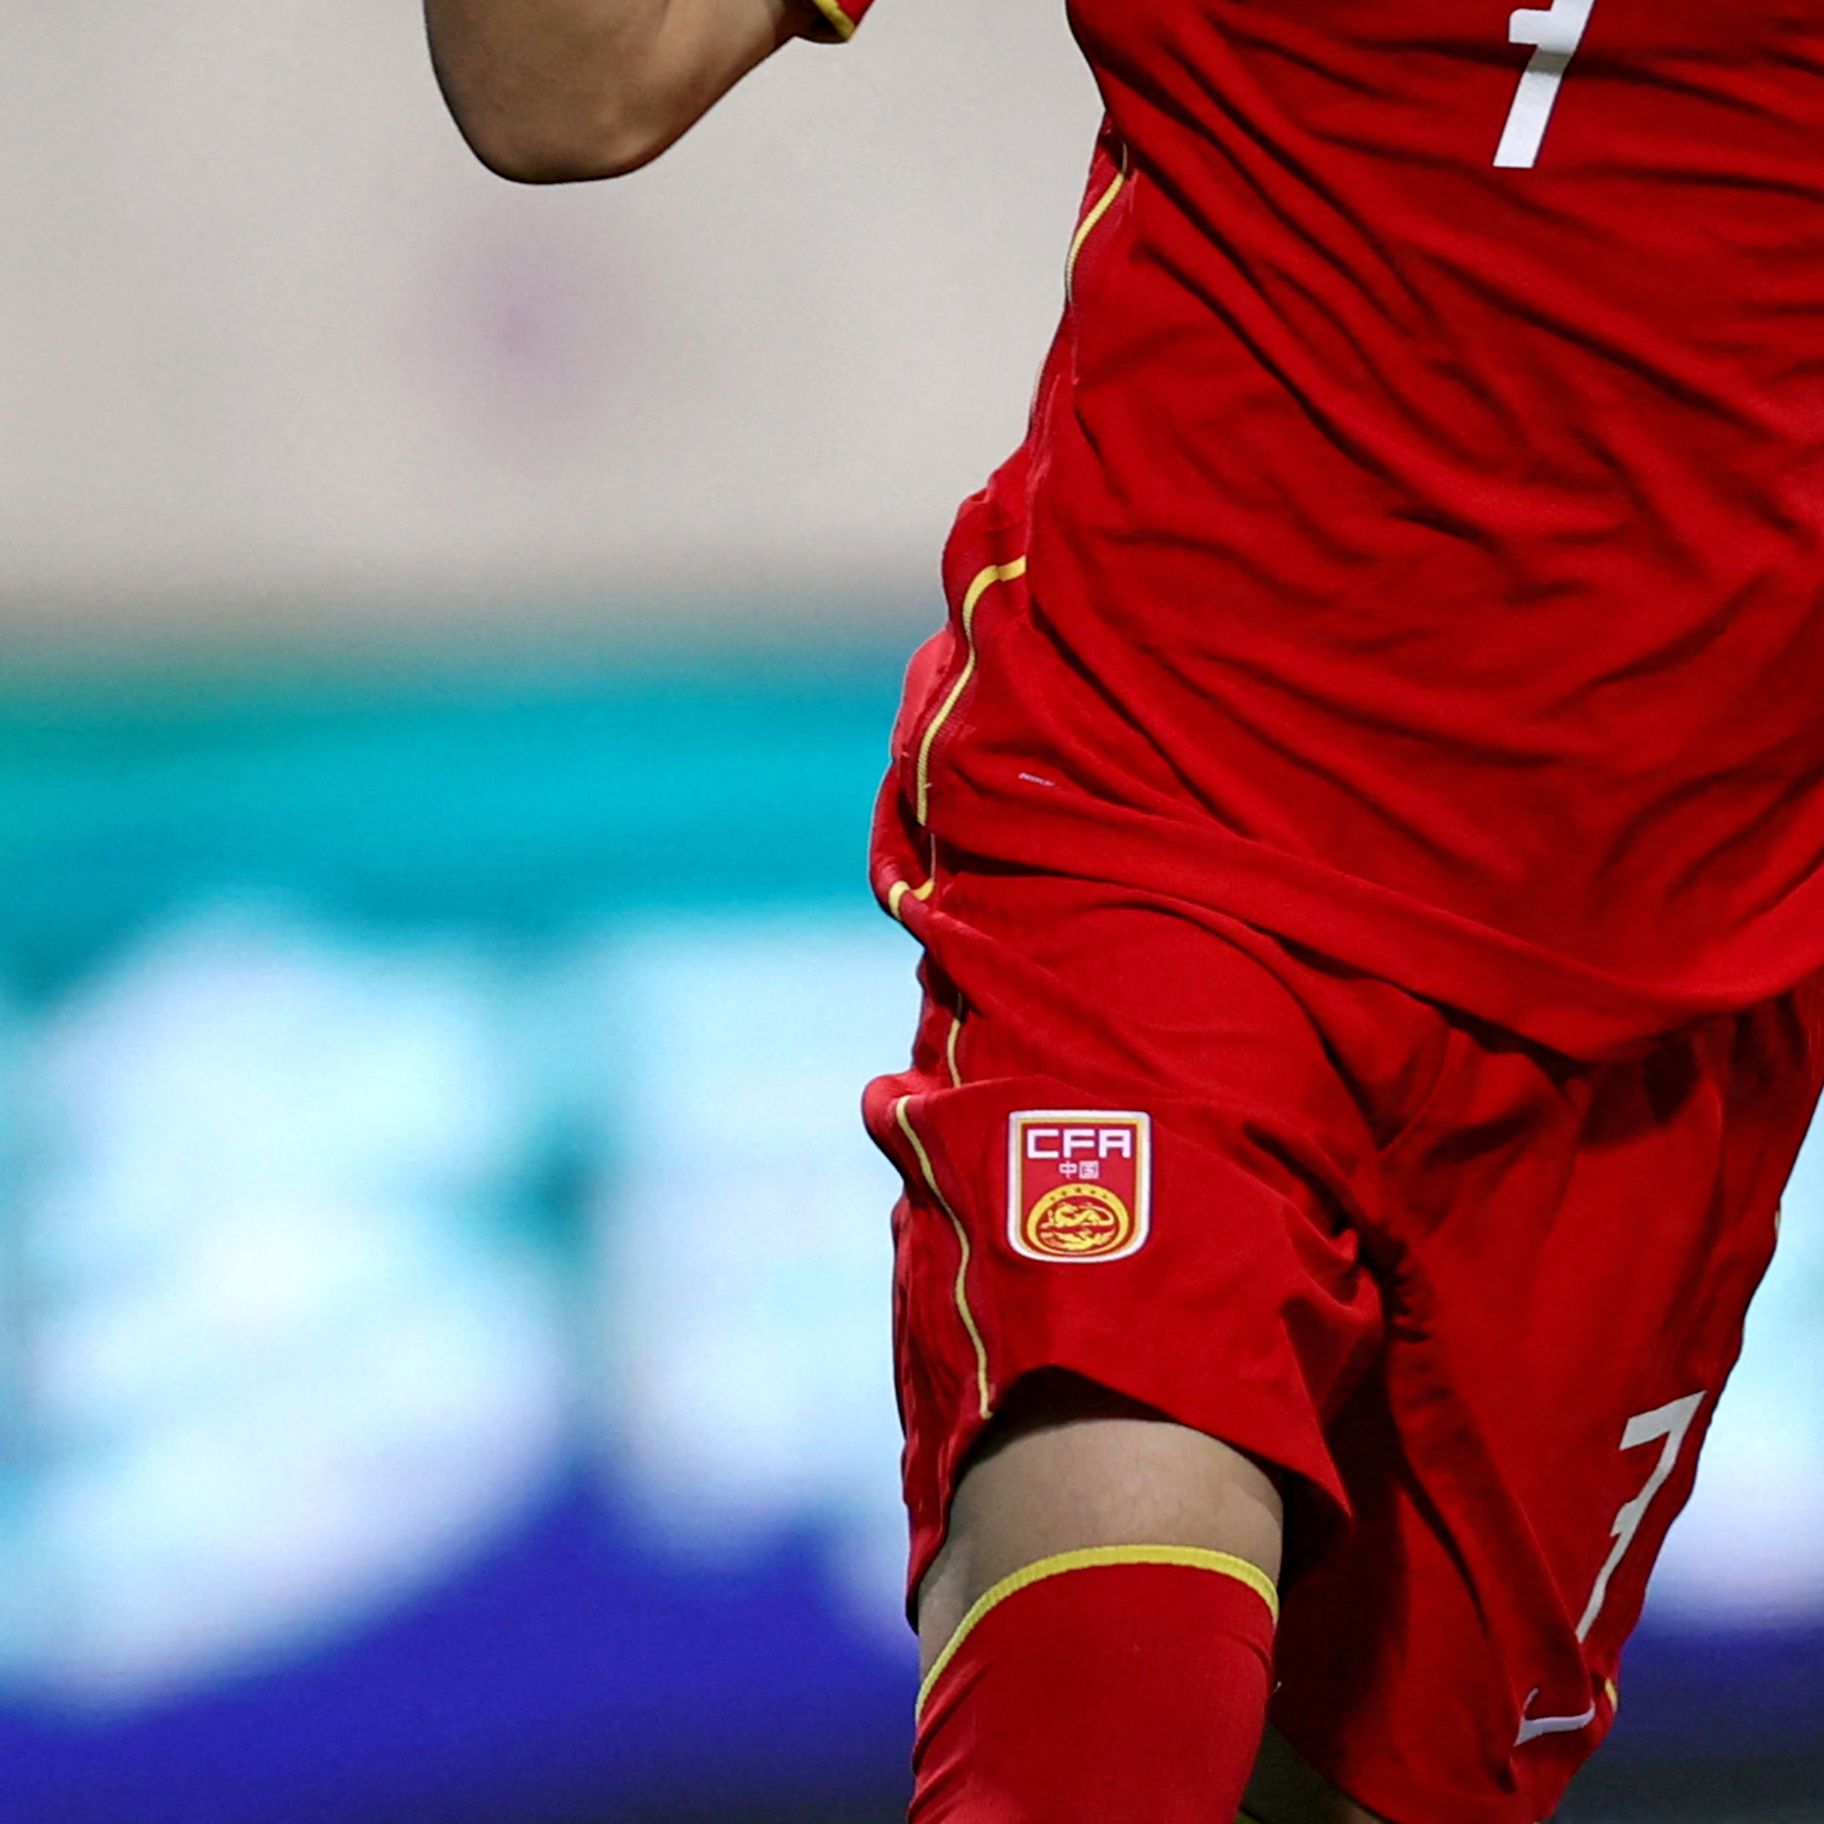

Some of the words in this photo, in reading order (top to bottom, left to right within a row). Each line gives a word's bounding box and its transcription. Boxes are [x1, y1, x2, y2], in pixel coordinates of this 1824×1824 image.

[1027, 1129, 1132, 1159] CFA
[1059, 1160, 1100, 1179] 中国
[1576, 1390, 1707, 1644] 7
